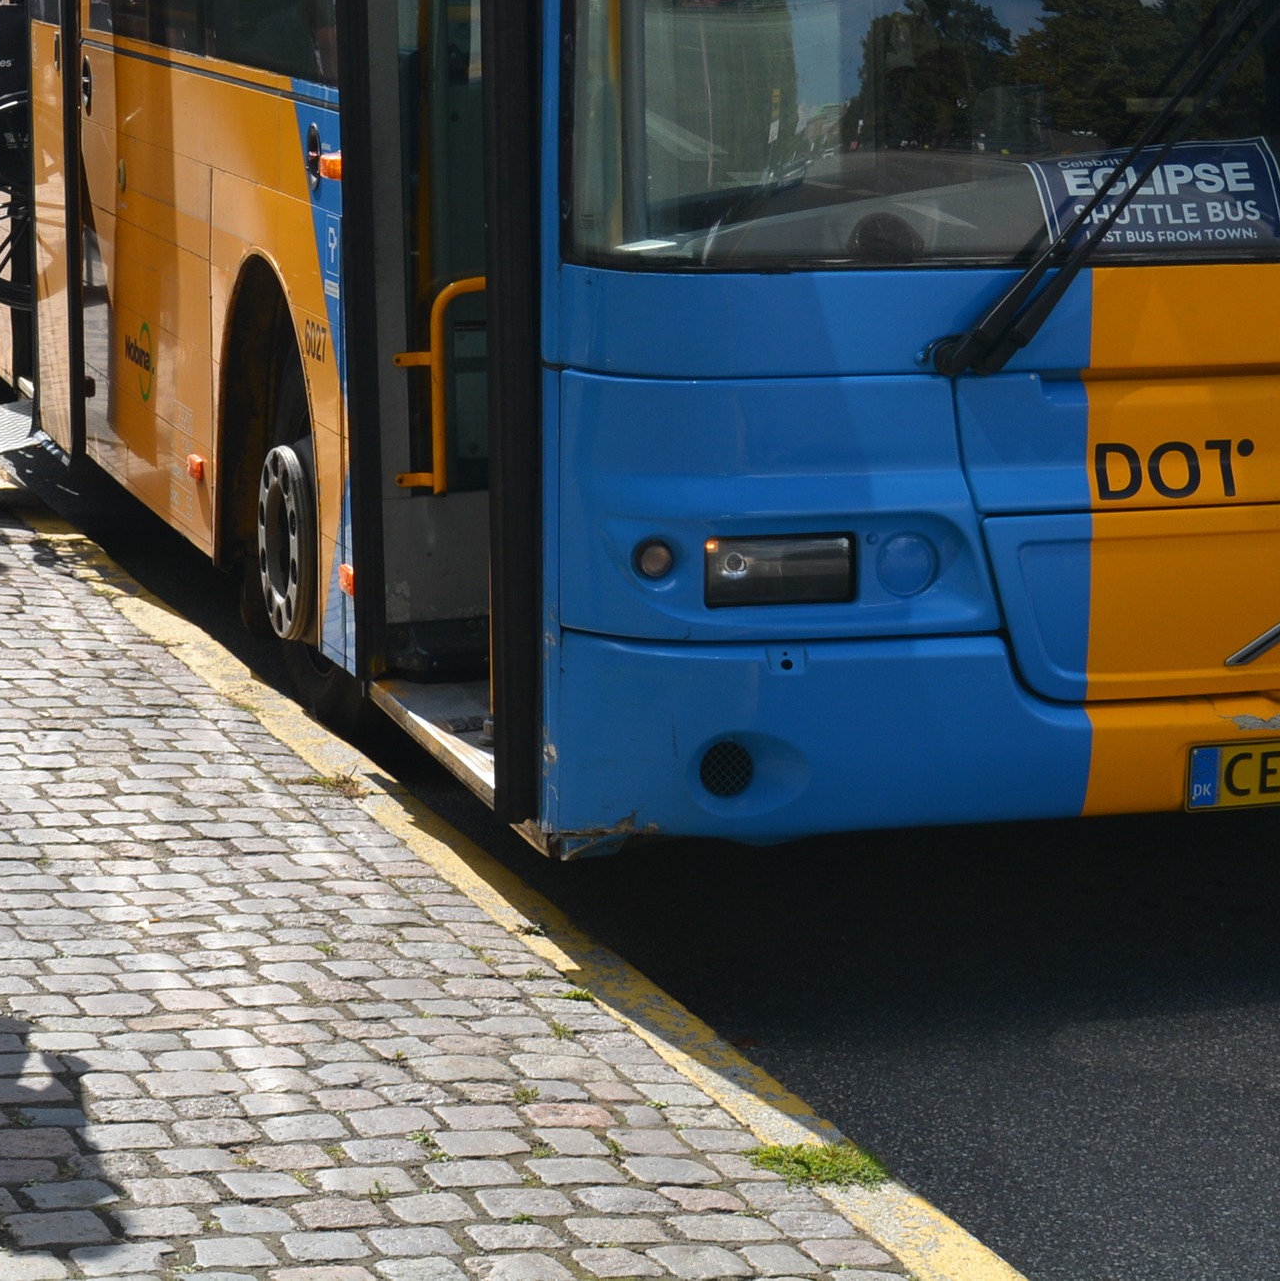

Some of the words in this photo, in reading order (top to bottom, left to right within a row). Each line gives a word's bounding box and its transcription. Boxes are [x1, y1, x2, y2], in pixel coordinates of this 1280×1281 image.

[1057, 157, 1124, 169] Celebrit
[1062, 162, 1255, 196] ECLIPSE
[1074, 203, 1201, 225] SHUTTLE
[1206, 200, 1261, 223] BUS
[1126, 230, 1155, 243] BUS
[1158, 229, 1203, 243] FROM
[1204, 227, 1258, 242] TOWN:
[304, 319, 327, 364] 6027
[1193, 783, 1212, 797] DK
